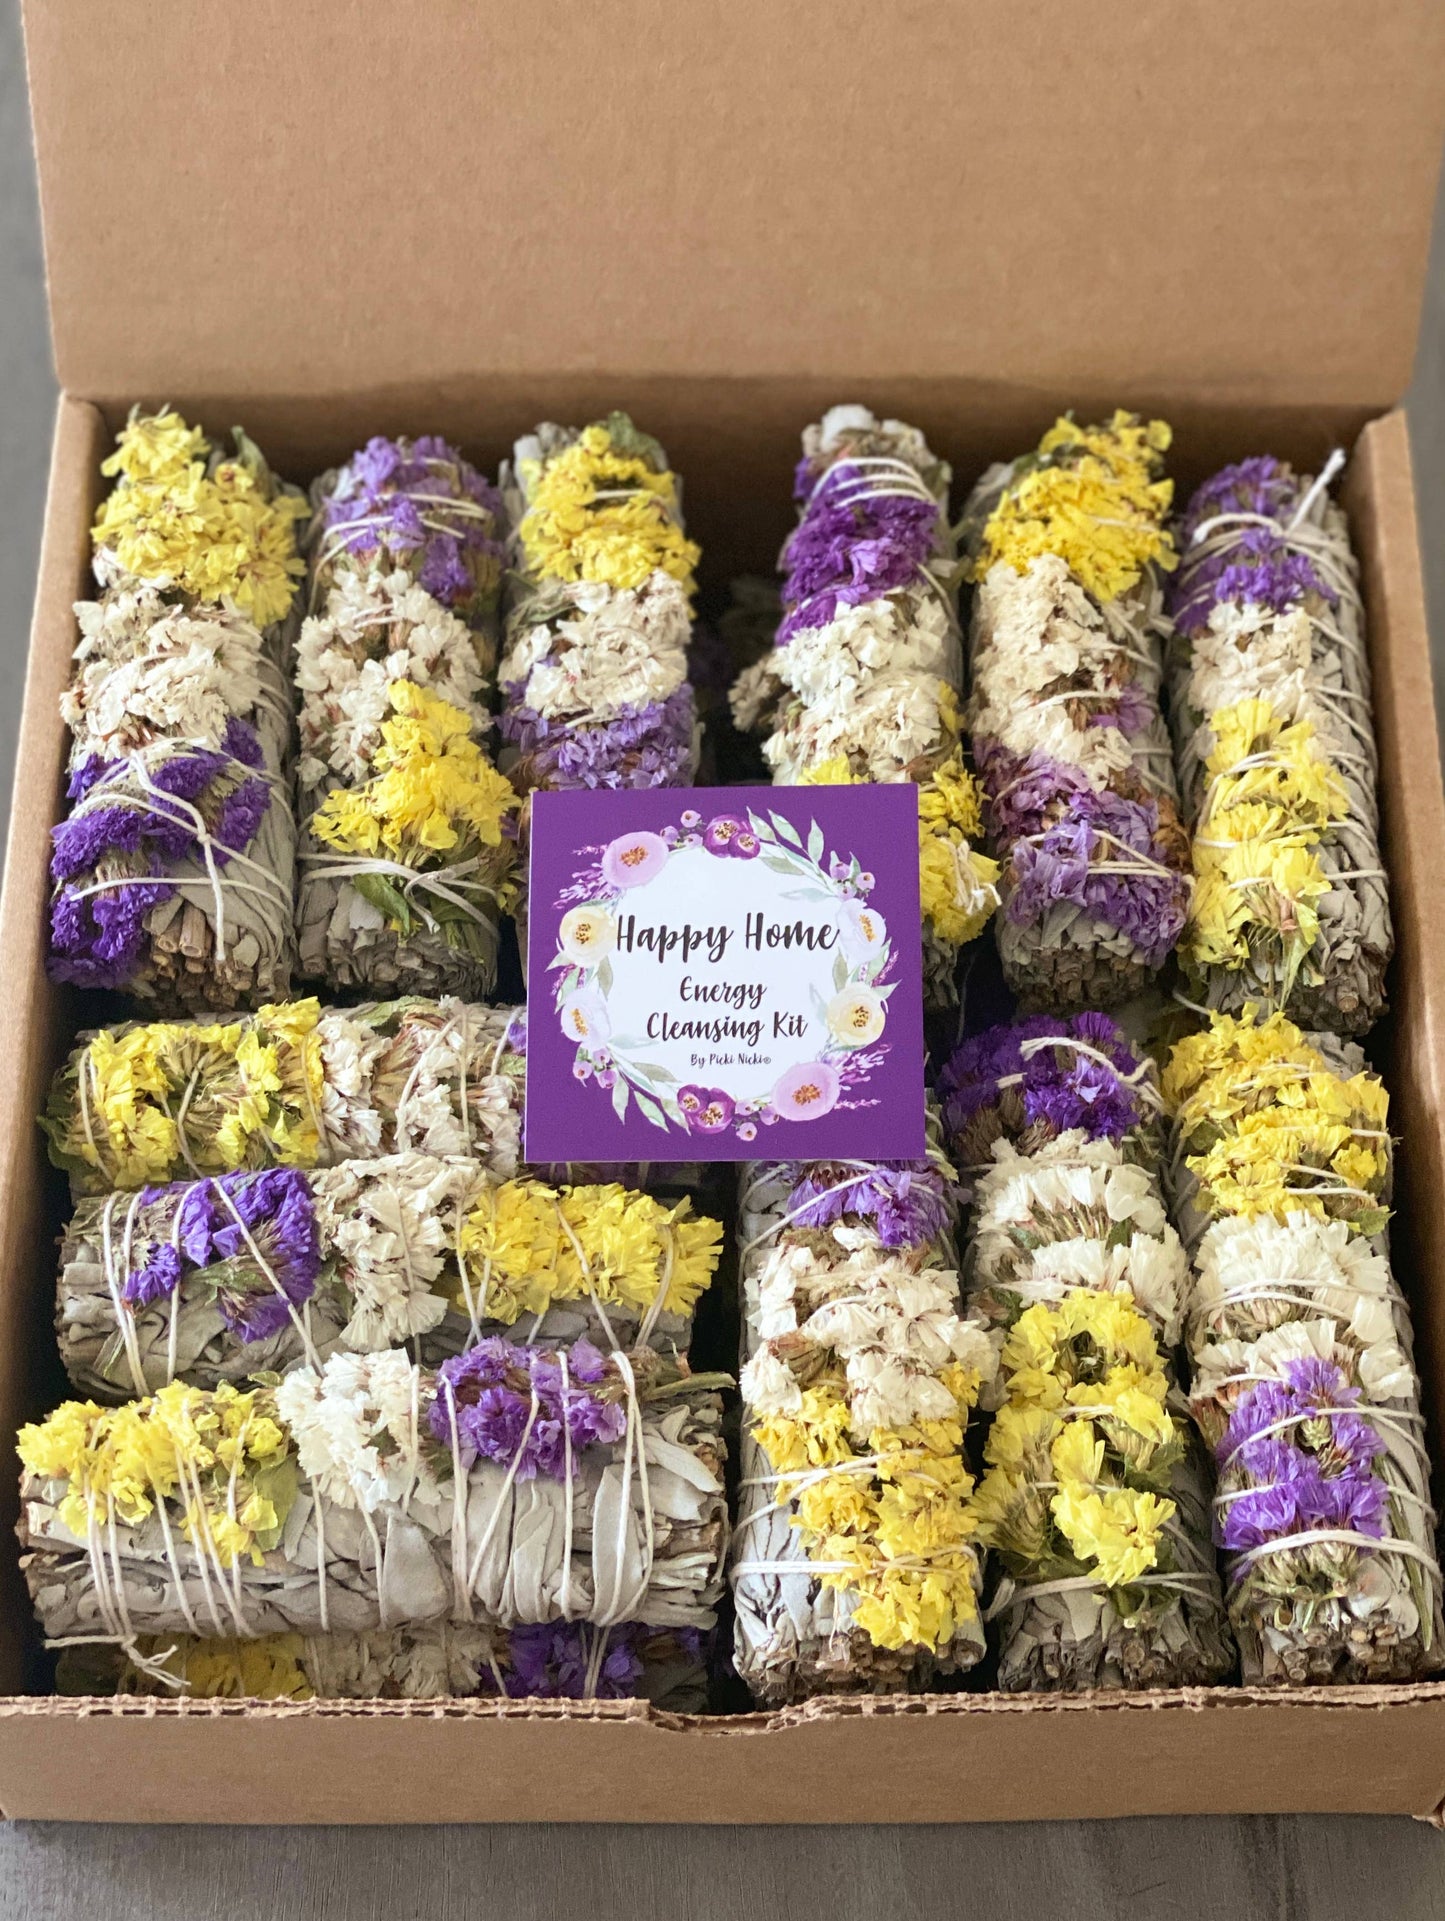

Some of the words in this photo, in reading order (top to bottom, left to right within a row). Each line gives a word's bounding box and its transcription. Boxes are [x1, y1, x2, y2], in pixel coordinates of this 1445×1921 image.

[616, 914, 734, 963] Happy
[745, 912, 840, 952] Home
[679, 976, 768, 1010] Energy
[647, 1013, 764, 1047] Cleansing
[773, 1012, 808, 1039] Kit
[690, 1053, 707, 1069] By
[709, 1053, 735, 1066] Picki
